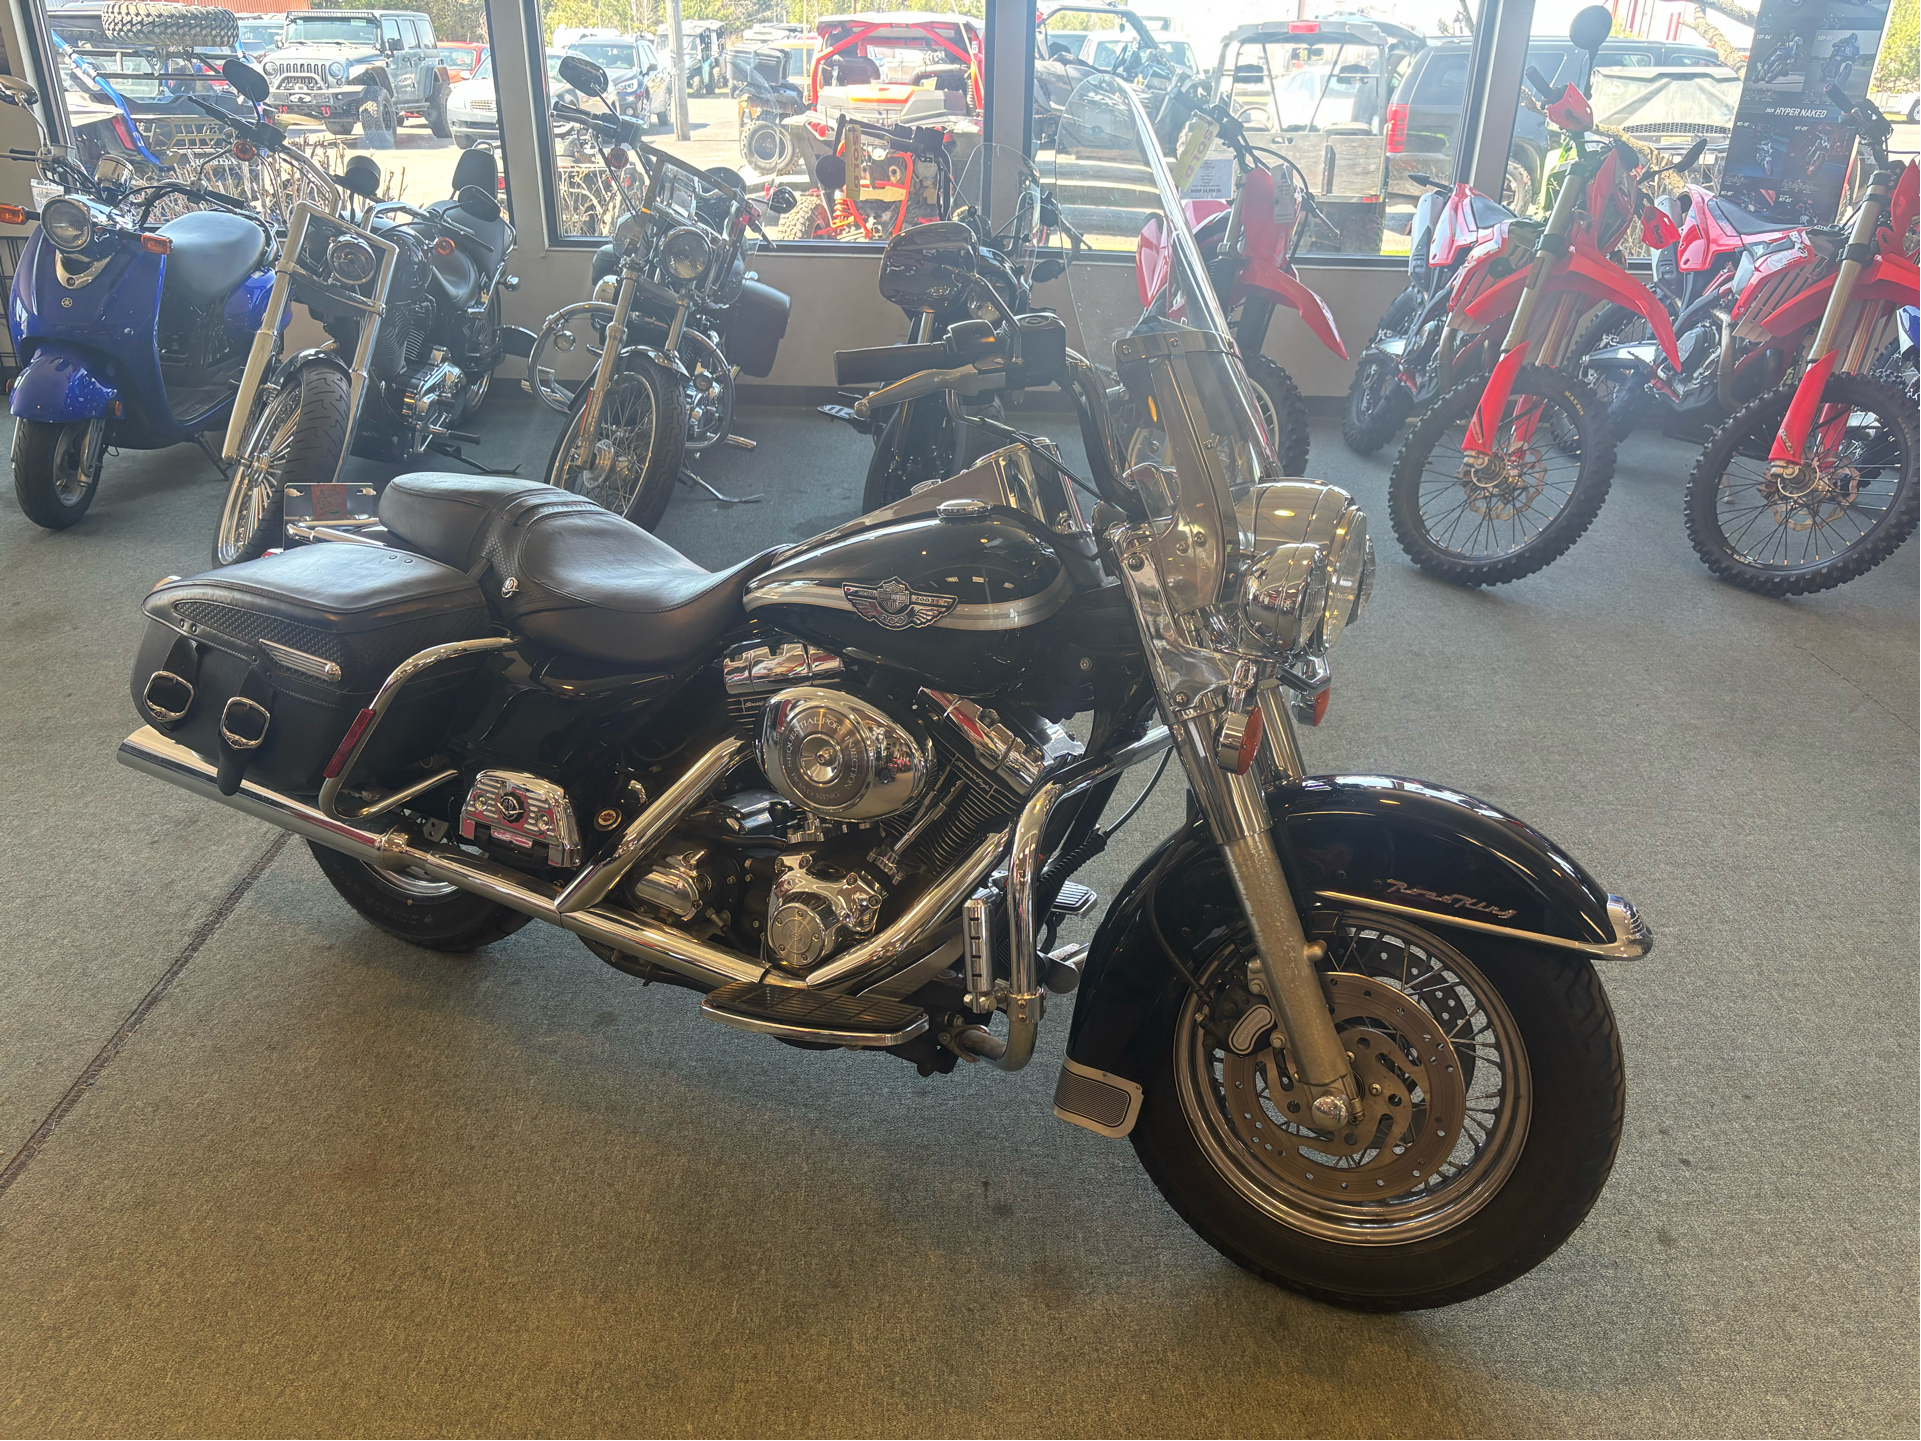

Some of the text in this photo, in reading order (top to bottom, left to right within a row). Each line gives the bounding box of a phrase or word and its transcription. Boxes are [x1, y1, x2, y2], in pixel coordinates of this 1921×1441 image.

[1775, 107, 1800, 117] HYPER
[1800, 108, 1828, 118] NAKED
[852, 133, 860, 189] SOLD
[1185, 128, 1214, 179] SOLD
[1564, 390, 1584, 416] MAXXIS
[786, 717, 859, 790] SEQUENTIAL PORT INJECTION
[791, 772, 840, 800] ROAD KING
[1386, 878, 1517, 919] Road King
